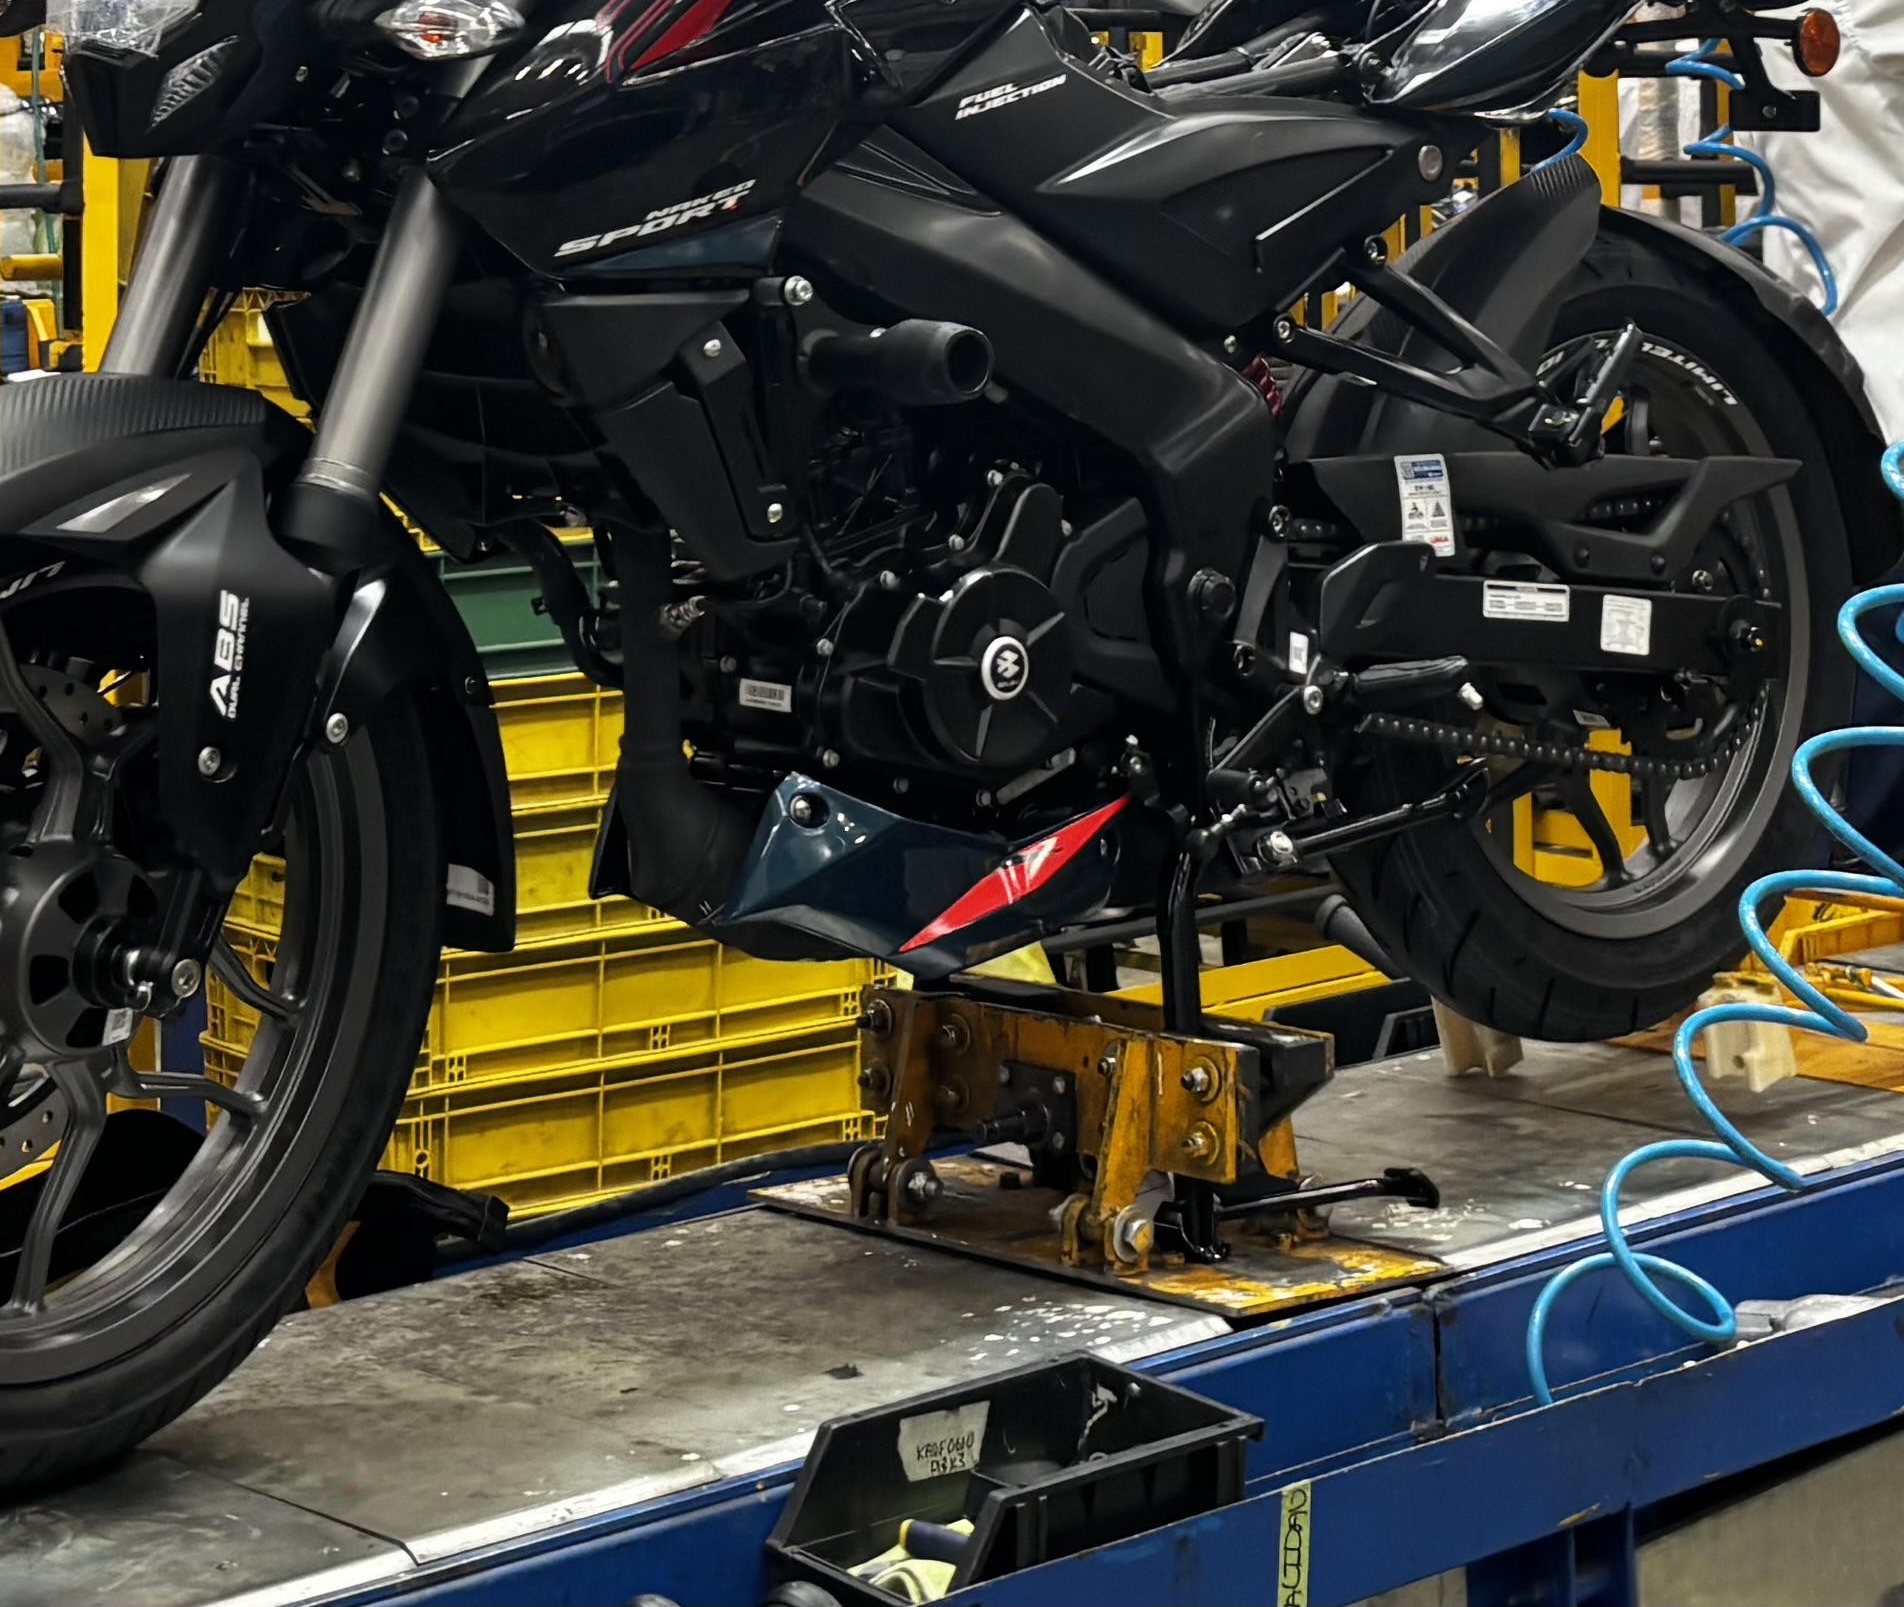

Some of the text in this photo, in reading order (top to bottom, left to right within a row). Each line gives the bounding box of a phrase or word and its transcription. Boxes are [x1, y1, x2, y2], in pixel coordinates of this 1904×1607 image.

[955, 74, 1066, 120] INJECTION
[959, 82, 1019, 108] FUEL
[644, 179, 756, 221] NAKED
[554, 190, 750, 257] SPORT
[209, 589, 239, 716] ABS
